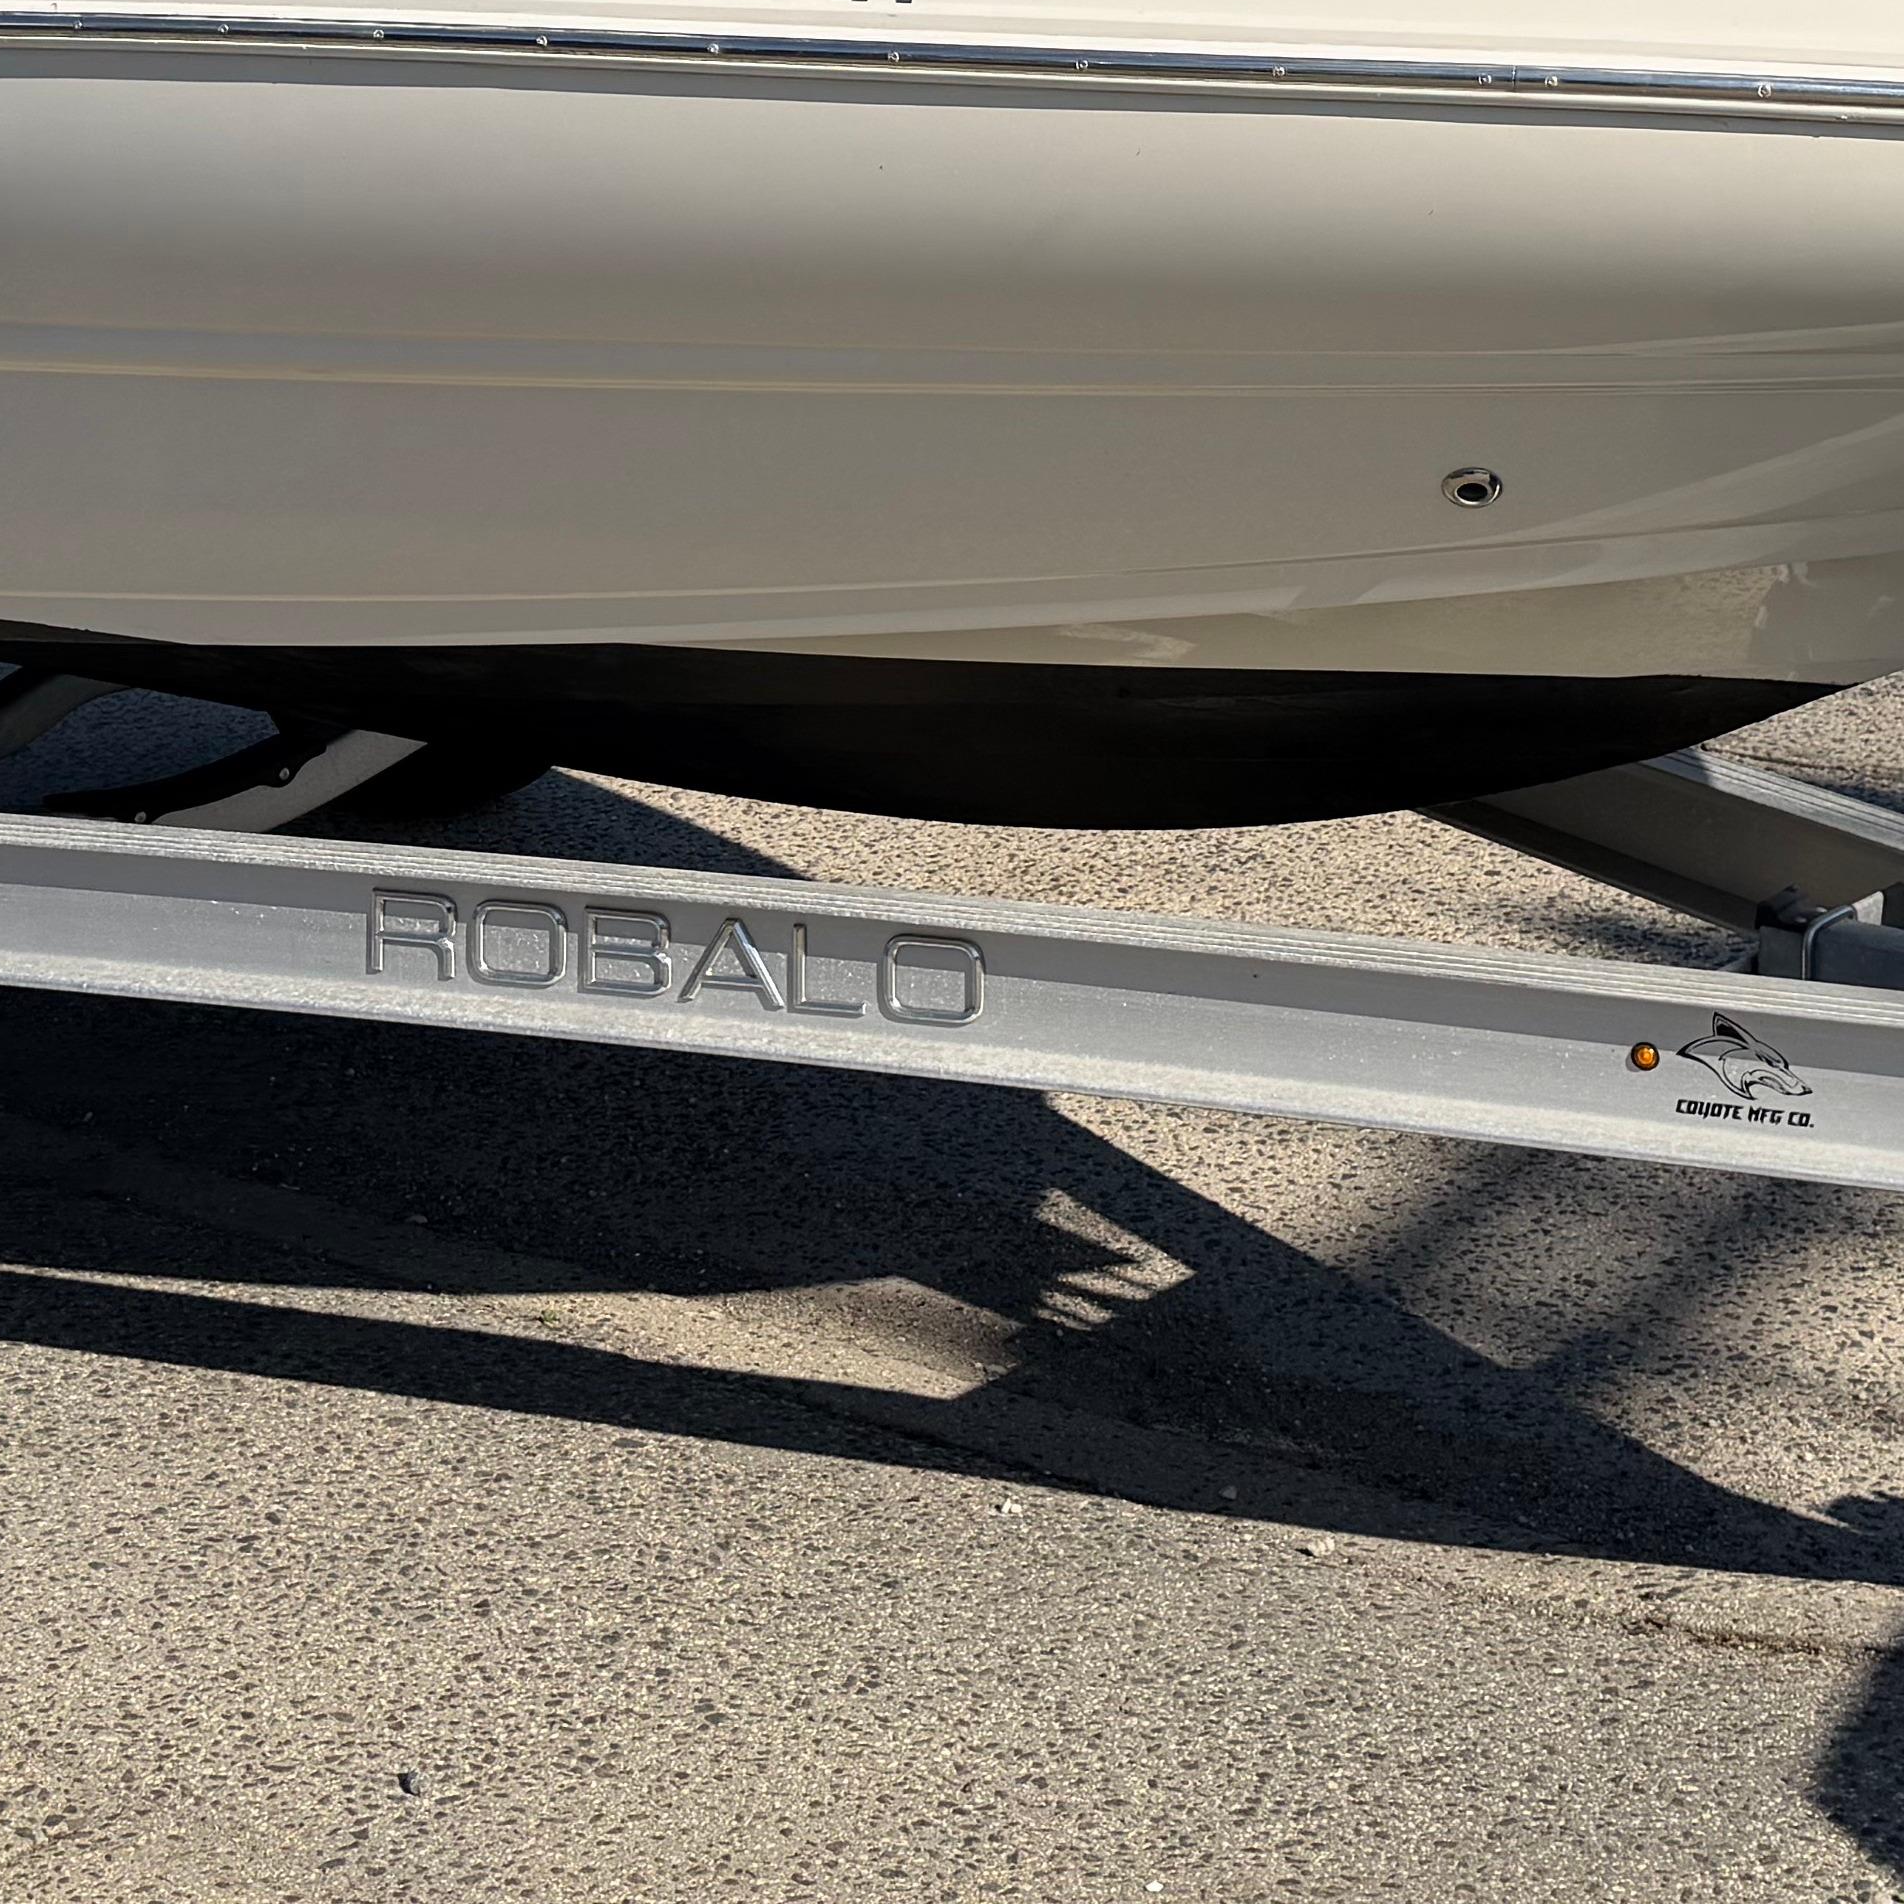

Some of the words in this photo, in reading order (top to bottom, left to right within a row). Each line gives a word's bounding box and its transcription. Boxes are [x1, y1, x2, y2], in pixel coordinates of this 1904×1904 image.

[366, 888, 985, 1026] ROBALO
[1675, 1098, 1744, 1121] COYOTE
[1747, 1105, 1785, 1125] MFG
[1787, 1111, 1815, 1128] CO.
